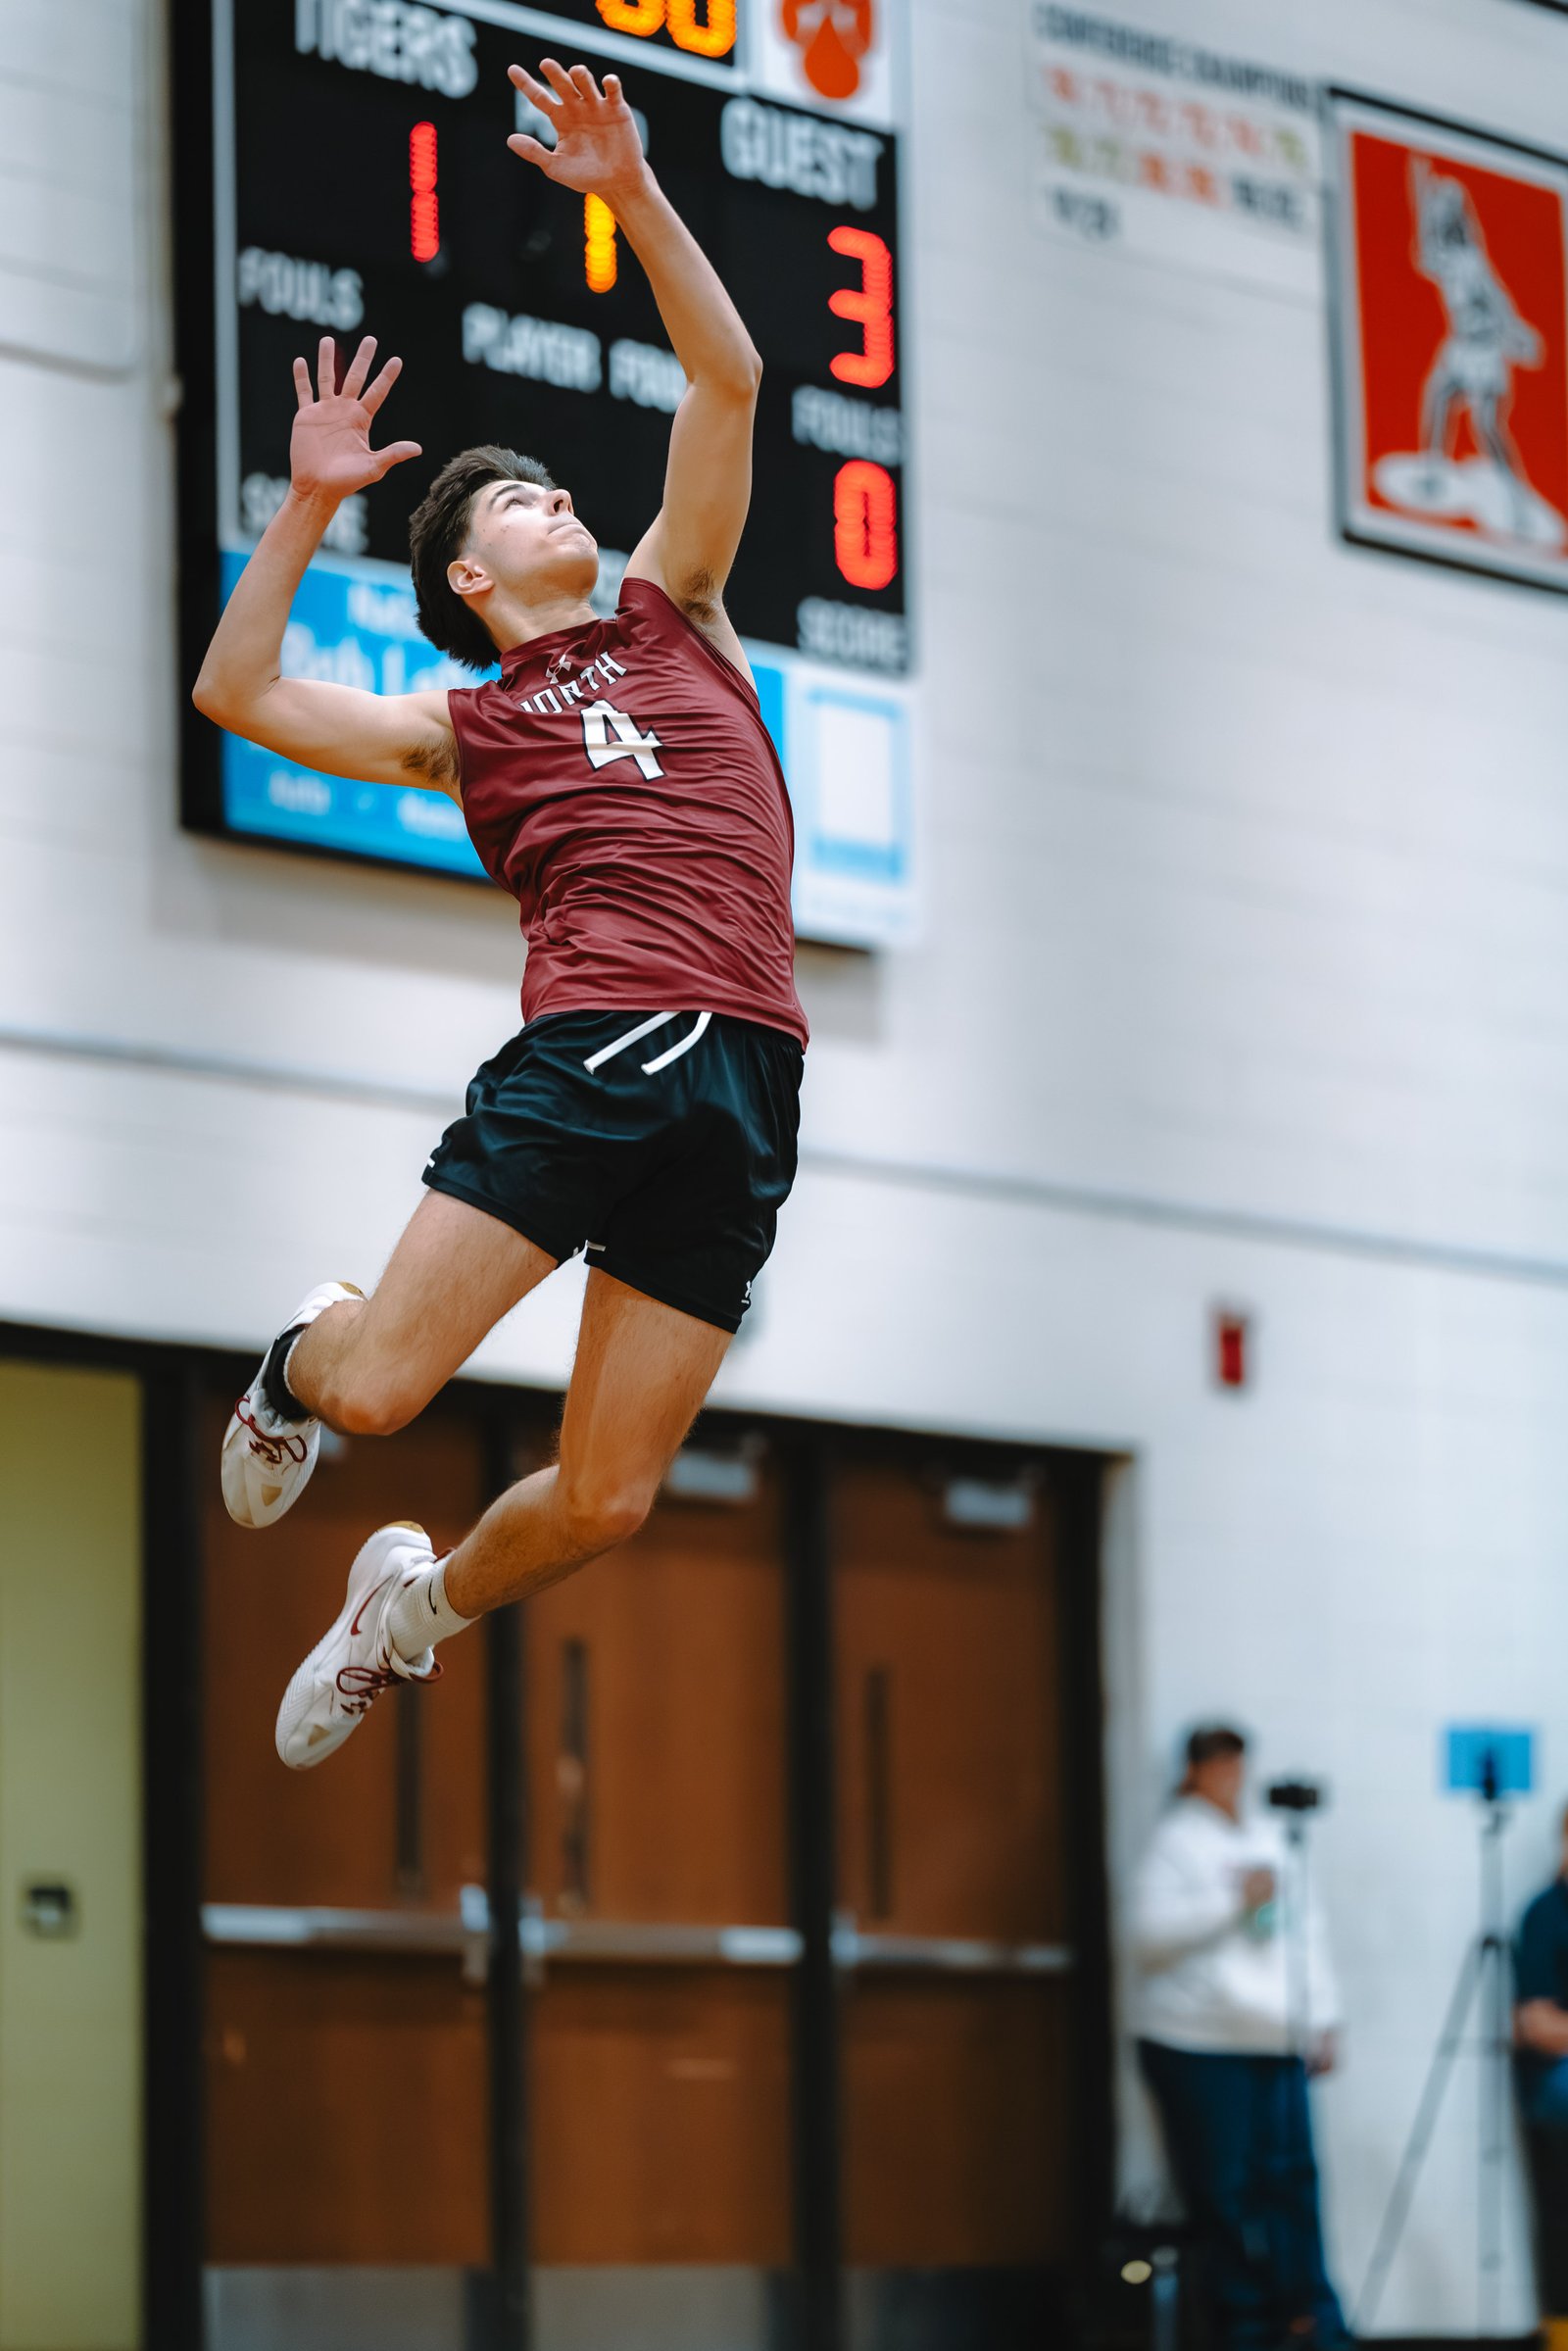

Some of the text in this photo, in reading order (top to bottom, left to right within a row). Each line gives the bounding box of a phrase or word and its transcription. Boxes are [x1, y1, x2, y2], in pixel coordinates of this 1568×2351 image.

[410, 122, 439, 262] 1
[720, 96, 884, 211] GUEST
[238, 245, 364, 331] FOULS
[828, 225, 894, 388] 3
[463, 302, 601, 392] PLAYER
[791, 384, 901, 467] FOULS
[834, 460, 898, 590] 0
[796, 596, 906, 674] SCORE
[580, 698, 667, 782] 4
